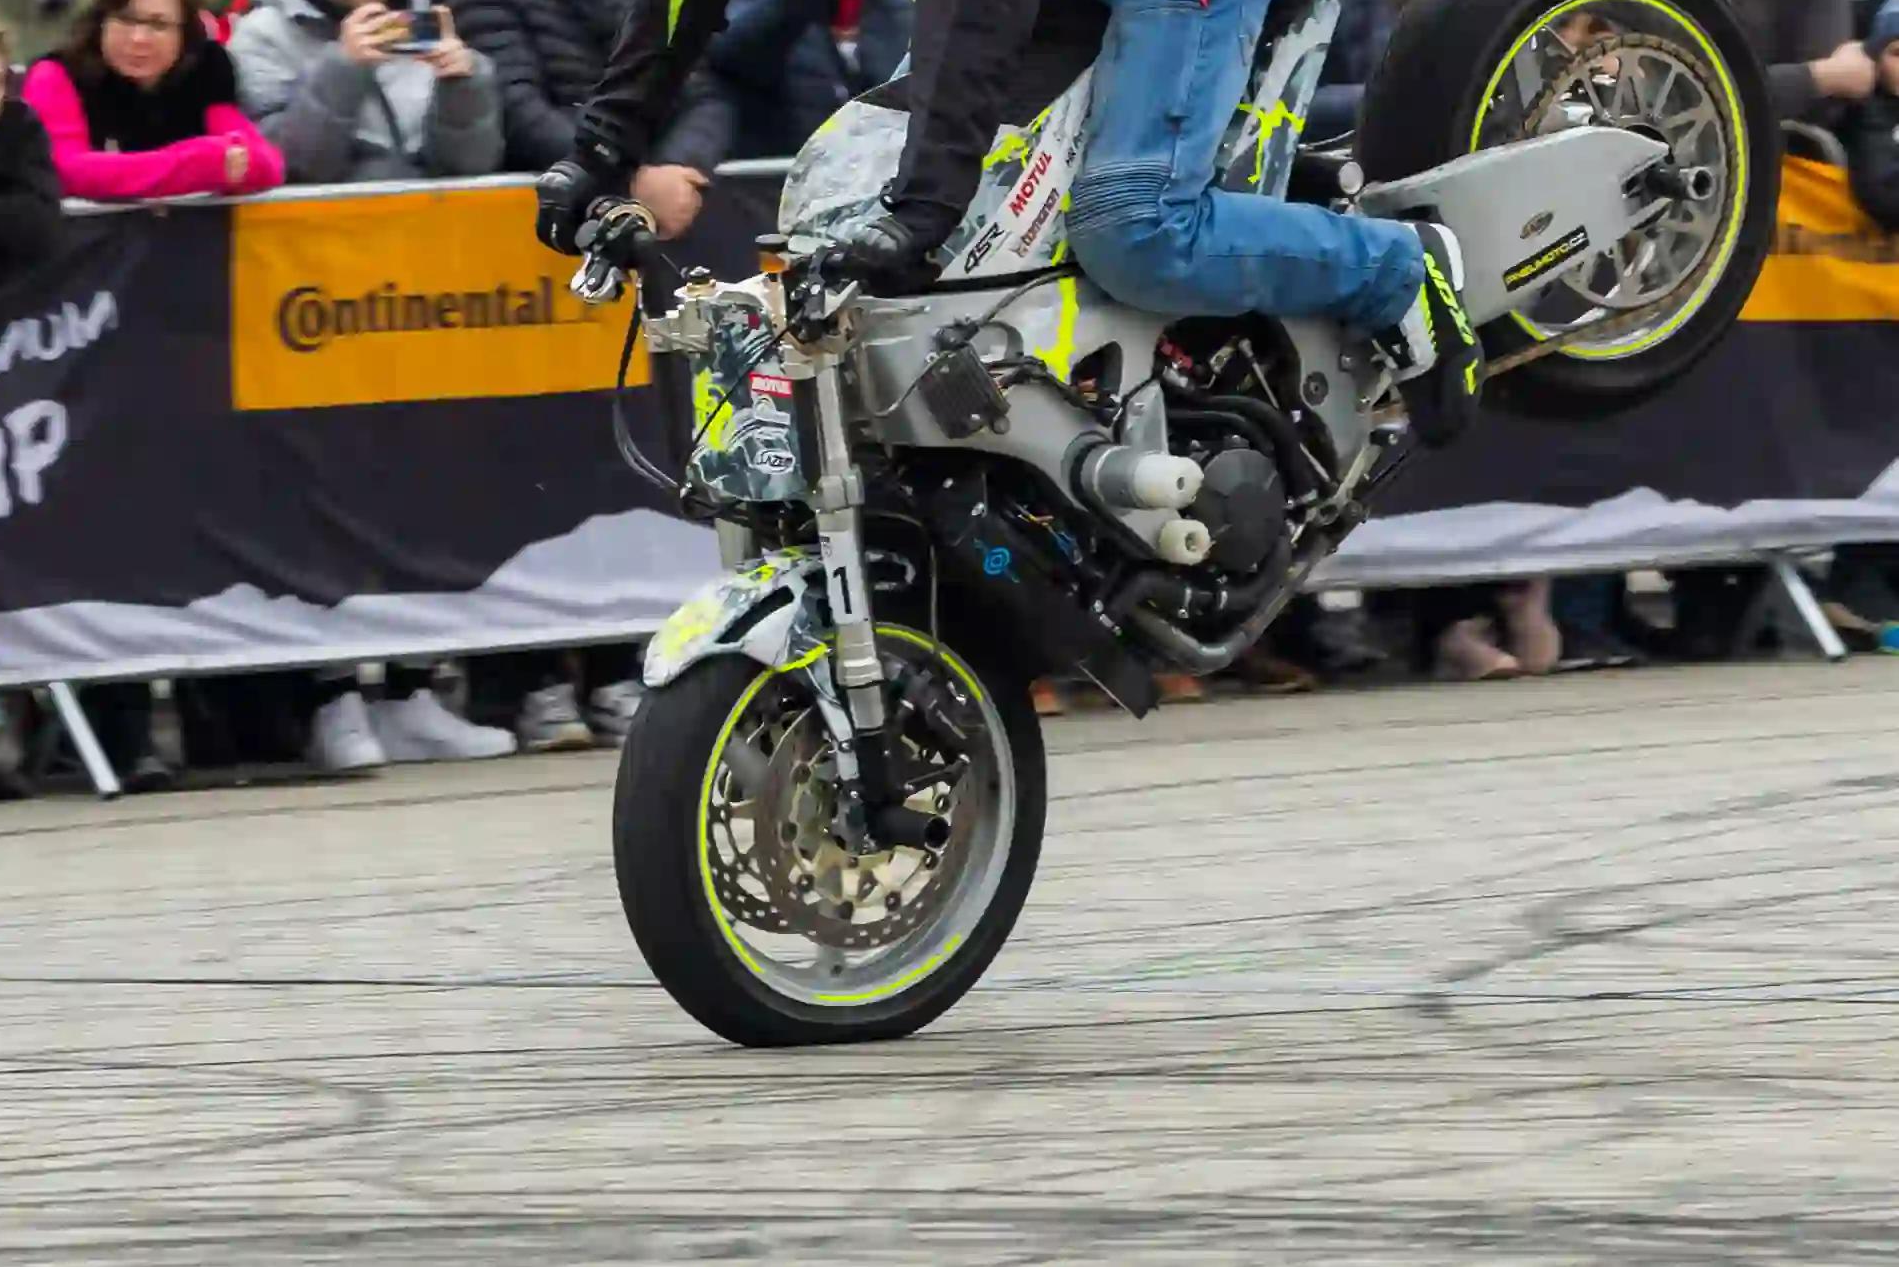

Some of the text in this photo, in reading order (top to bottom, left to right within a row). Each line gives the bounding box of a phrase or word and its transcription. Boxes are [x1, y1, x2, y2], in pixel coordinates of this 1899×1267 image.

[1008, 151, 1053, 218] MOTUL
[277, 275, 555, 353] Continental
[832, 565, 853, 615] 1
